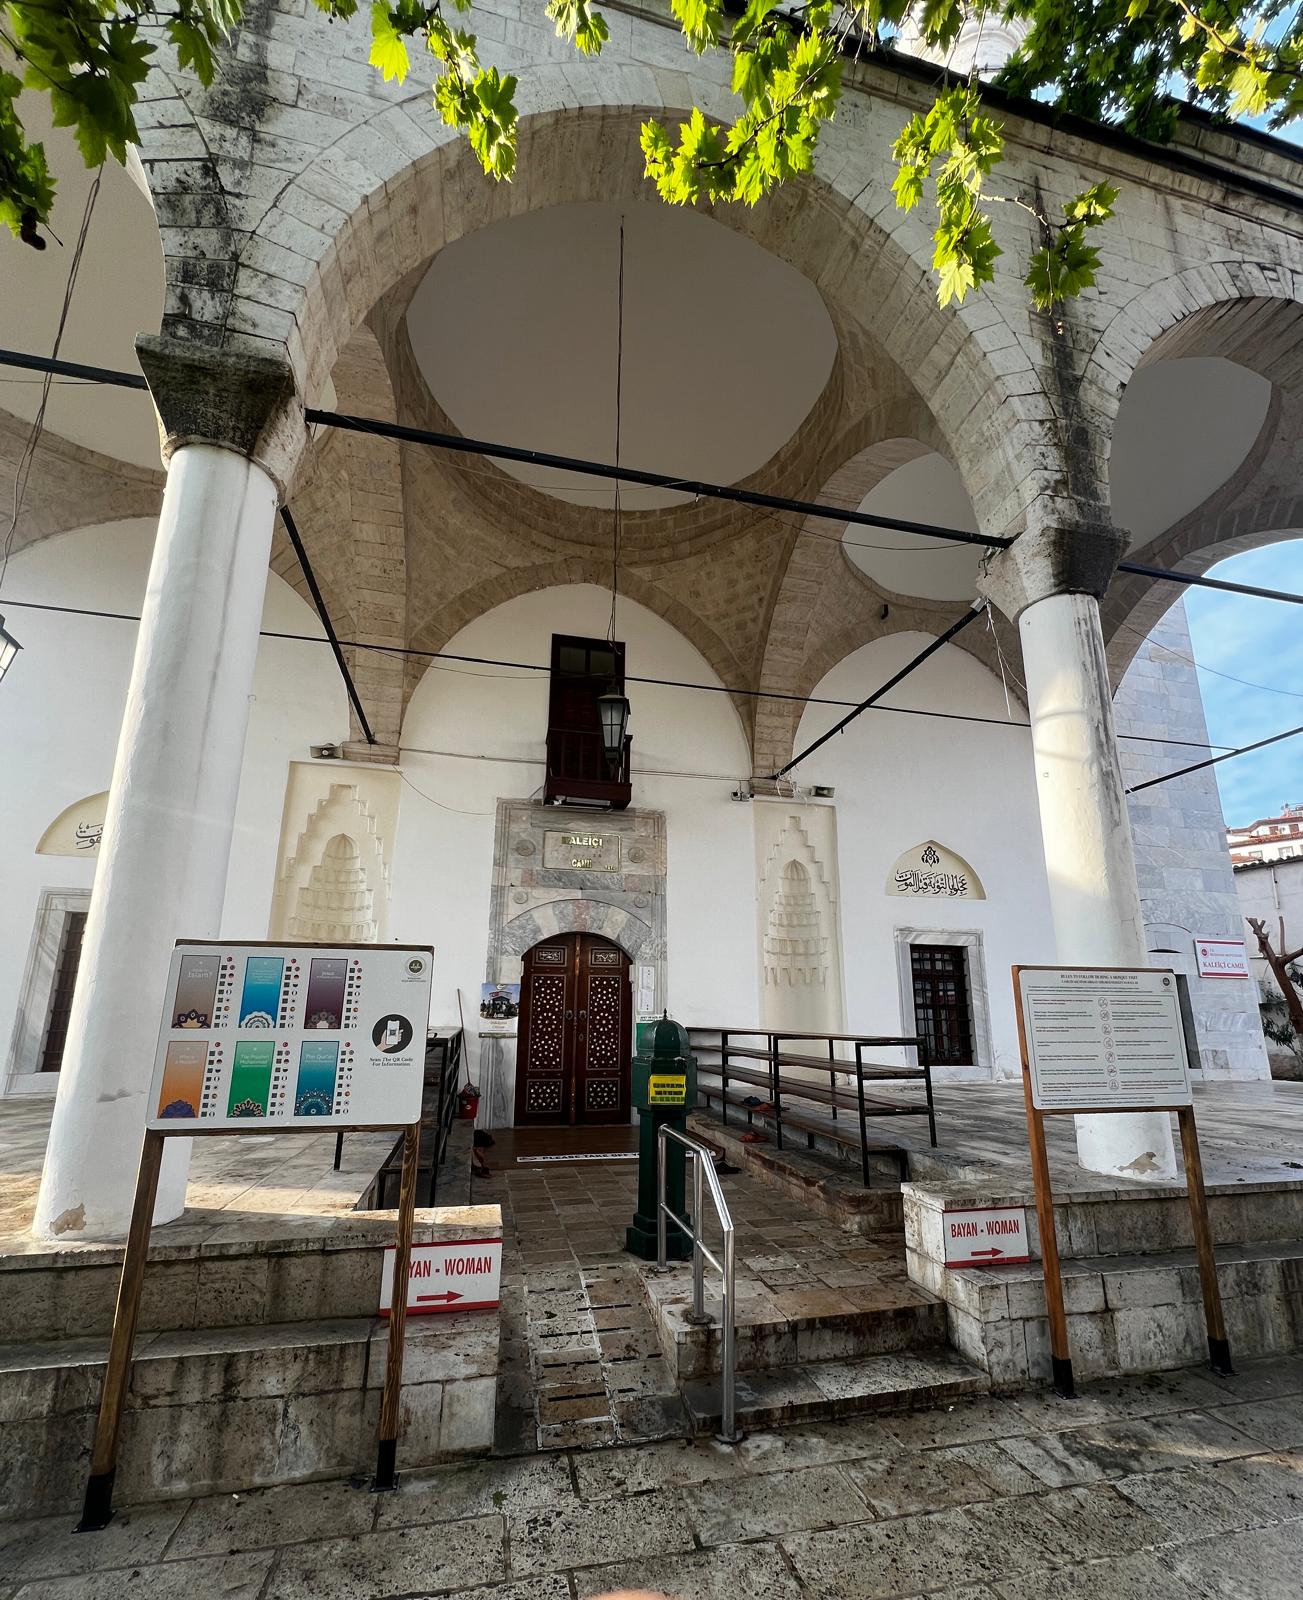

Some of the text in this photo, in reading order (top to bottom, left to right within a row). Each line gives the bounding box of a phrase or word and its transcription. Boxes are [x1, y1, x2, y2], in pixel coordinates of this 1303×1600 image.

[950, 1222, 978, 1238] BAYAN
[985, 1219, 1020, 1236] WOMAN
[409, 1260, 431, 1278] YAN
[444, 1257, 492, 1276] WOMAN
